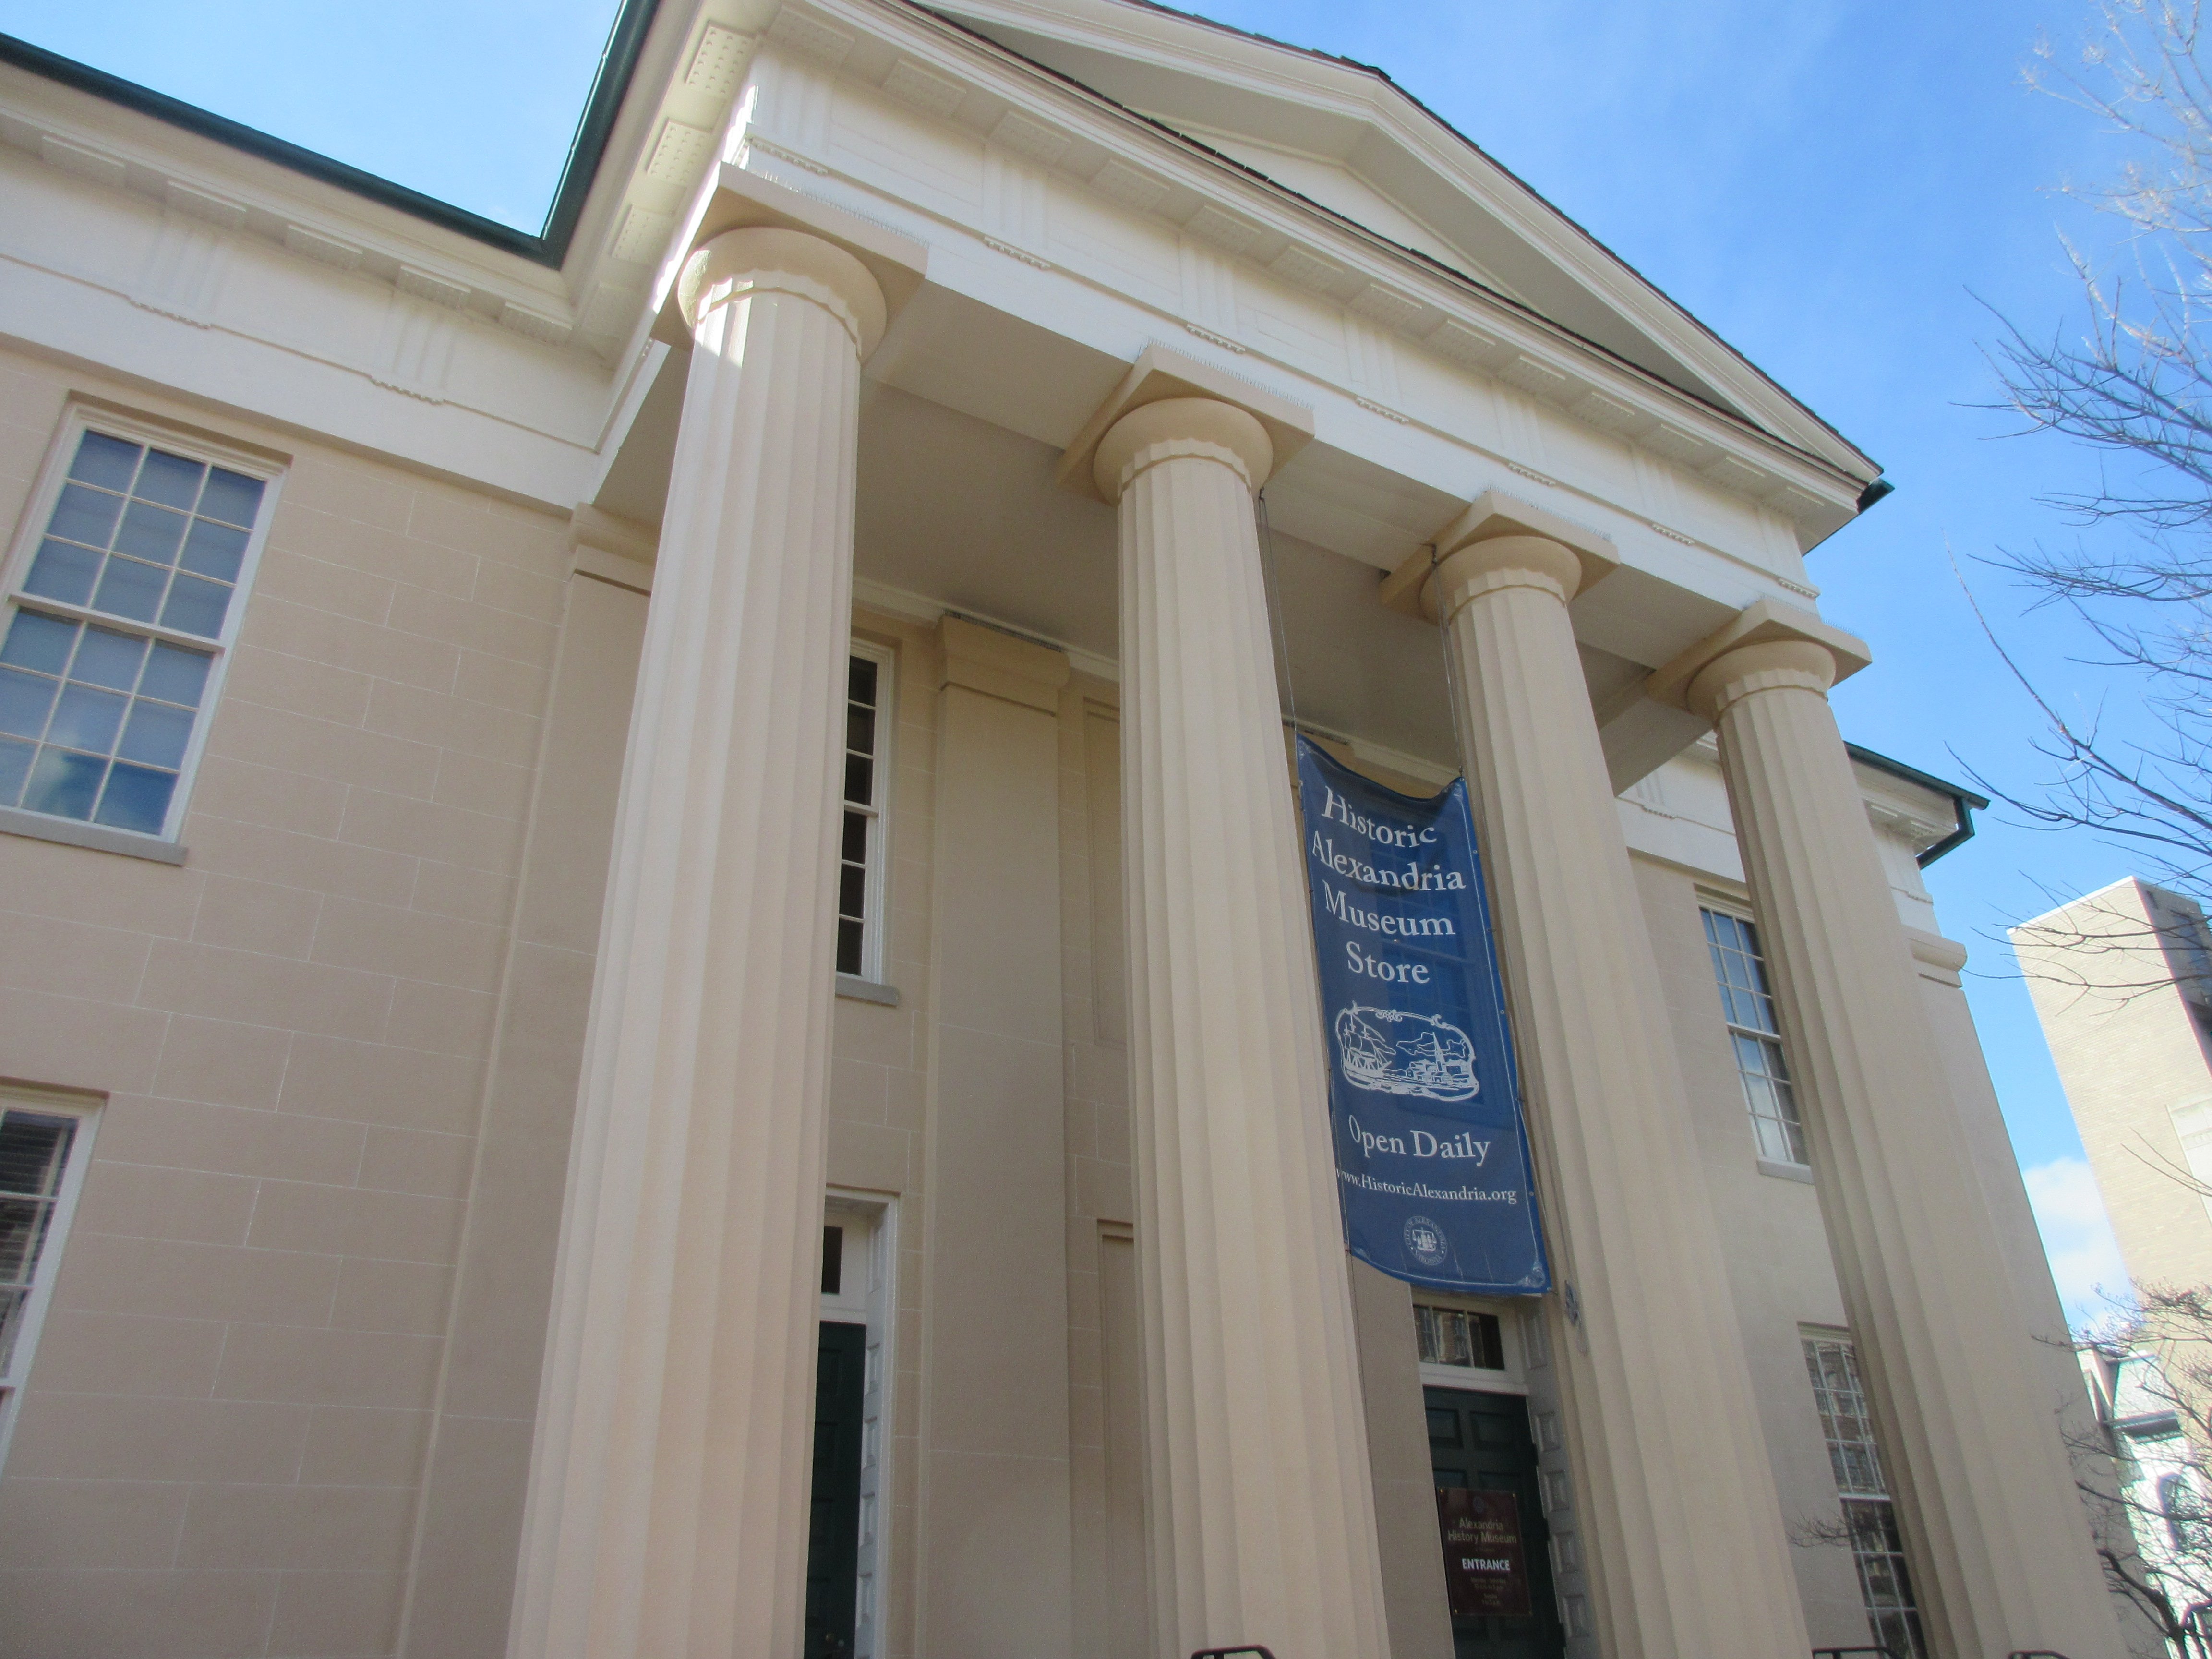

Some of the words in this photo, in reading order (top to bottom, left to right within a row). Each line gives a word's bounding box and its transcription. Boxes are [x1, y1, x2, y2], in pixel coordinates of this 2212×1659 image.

[1321, 786, 1437, 848] Historic
[1312, 830, 1466, 890] Alexandria
[1322, 879, 1456, 936] Museum
[1346, 941, 1430, 984] Store
[1349, 1115, 1407, 1159] Open
[1409, 1130, 1491, 1166] Daily
[1448, 1529, 1479, 1544] History
[1481, 1531, 1517, 1544] Museum
[1459, 1517, 1503, 1530] Alexandria
[1462, 1558, 1510, 1570] ENTRANCE
